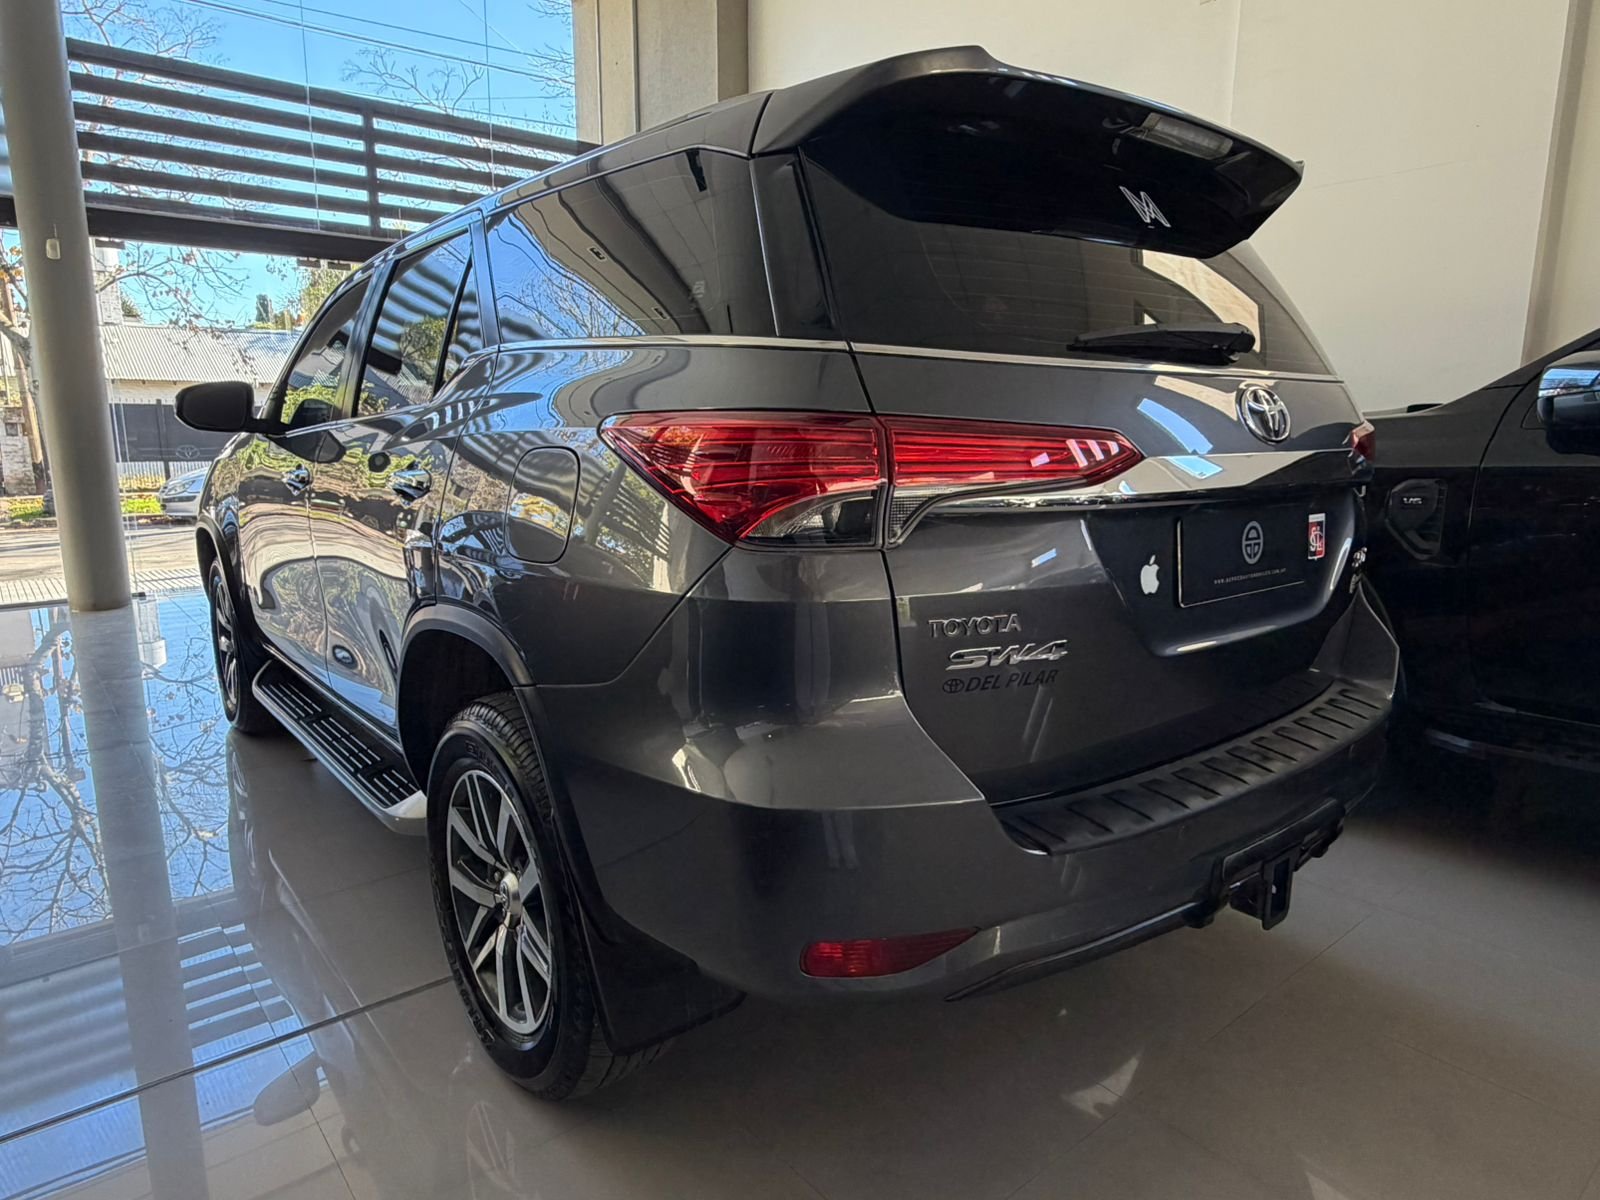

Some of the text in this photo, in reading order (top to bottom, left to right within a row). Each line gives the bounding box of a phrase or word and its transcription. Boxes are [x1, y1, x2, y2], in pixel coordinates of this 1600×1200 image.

[928, 613, 1022, 638] TOYOTA
[945, 639, 1068, 671] SW4
[964, 669, 1059, 692] DEL PILAR
